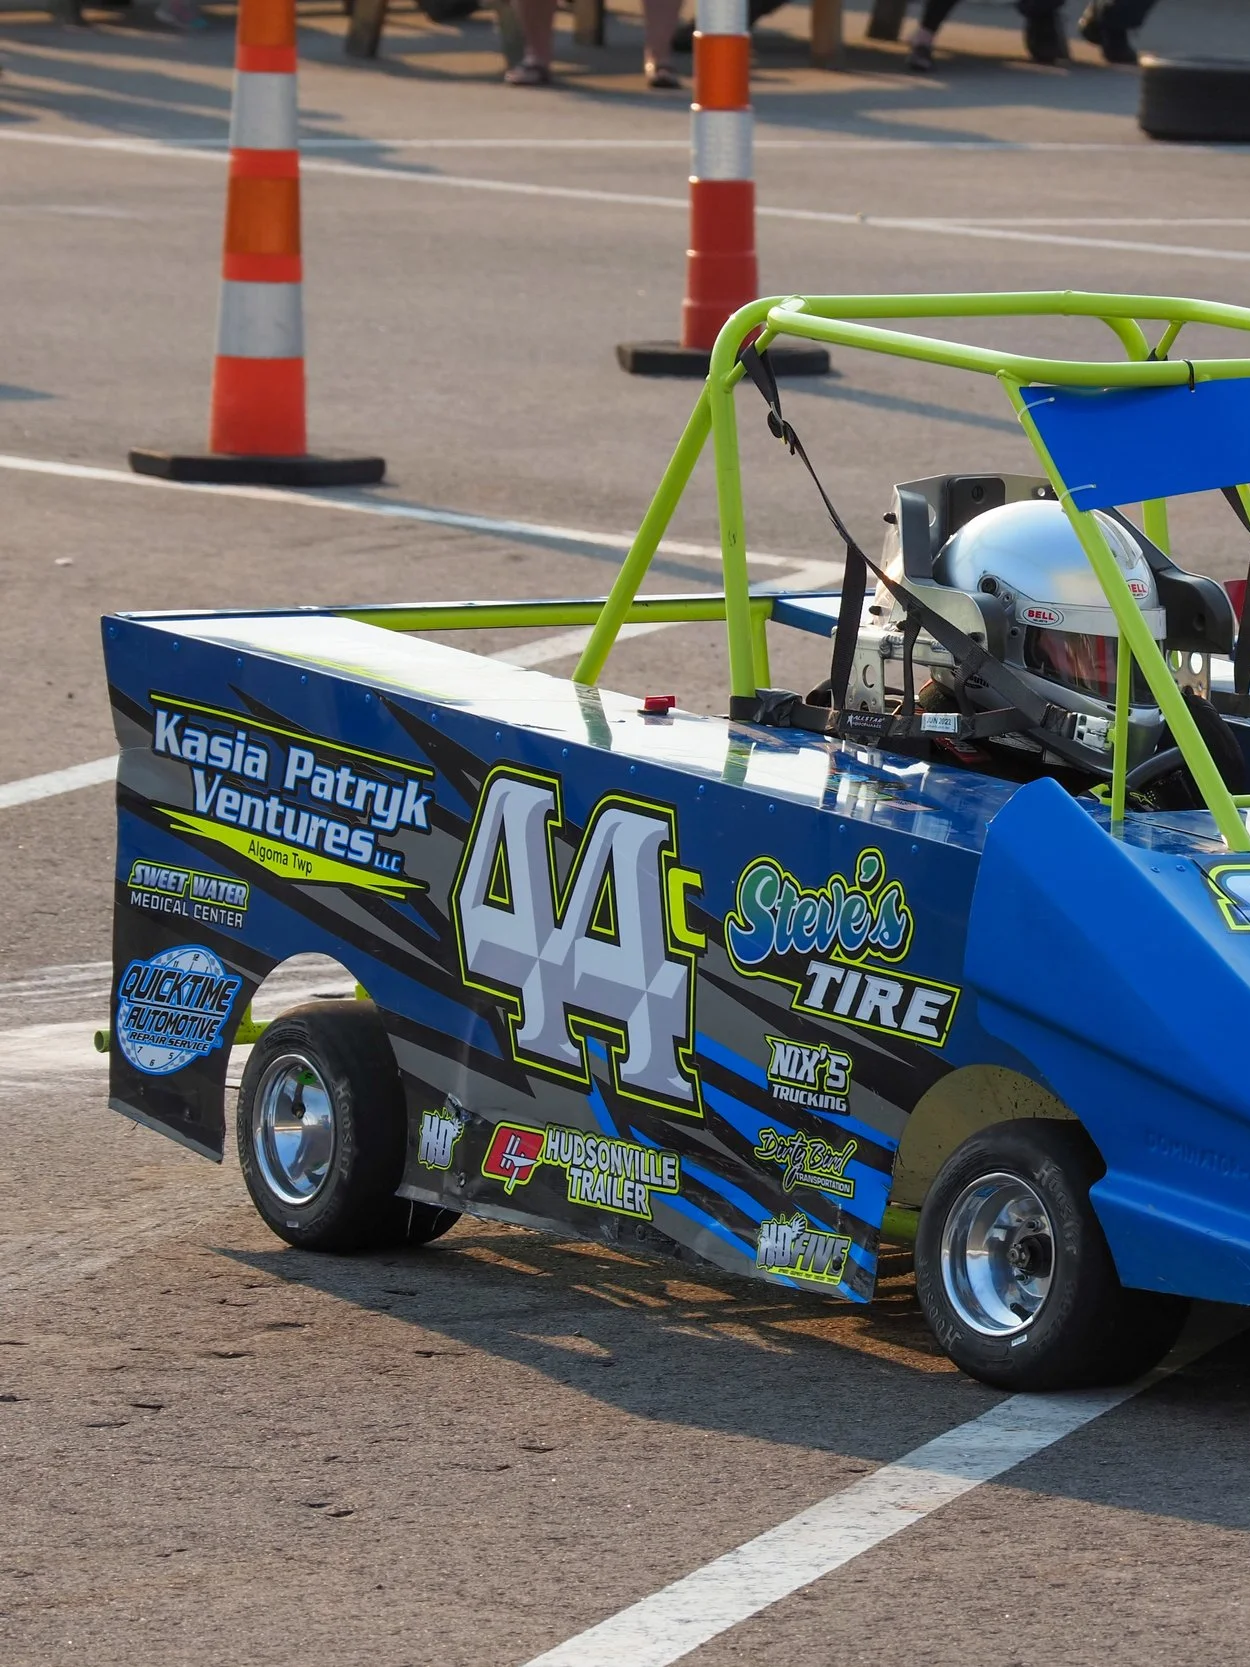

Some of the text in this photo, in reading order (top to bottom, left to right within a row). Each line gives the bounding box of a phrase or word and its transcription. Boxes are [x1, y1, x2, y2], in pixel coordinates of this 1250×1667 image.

[1027, 609, 1055, 620] BELL
[154, 709, 432, 830] Kasia Patryk
[192, 767, 401, 873] Ventures LLC
[248, 839, 313, 877] Algoma Twp
[131, 864, 248, 906] SWEET WATER
[131, 891, 243, 929] MEDICAL CENTER
[728, 855, 907, 965] Steve's
[121, 965, 238, 1013] QUICKTIME
[803, 960, 952, 1038] TIRE
[125, 1006, 221, 1042] AUTOMOTIVE
[129, 1032, 209, 1052] REPAIR SERVICE
[771, 1041, 849, 1089] NIX'S
[772, 1084, 848, 1112] TRUCKING
[546, 1129, 677, 1188] HUDSONVILLE
[759, 1132, 855, 1188] Dirty Bird
[570, 1167, 649, 1214] TRAILER
[795, 1172, 851, 1193] TRANSPORTATION
